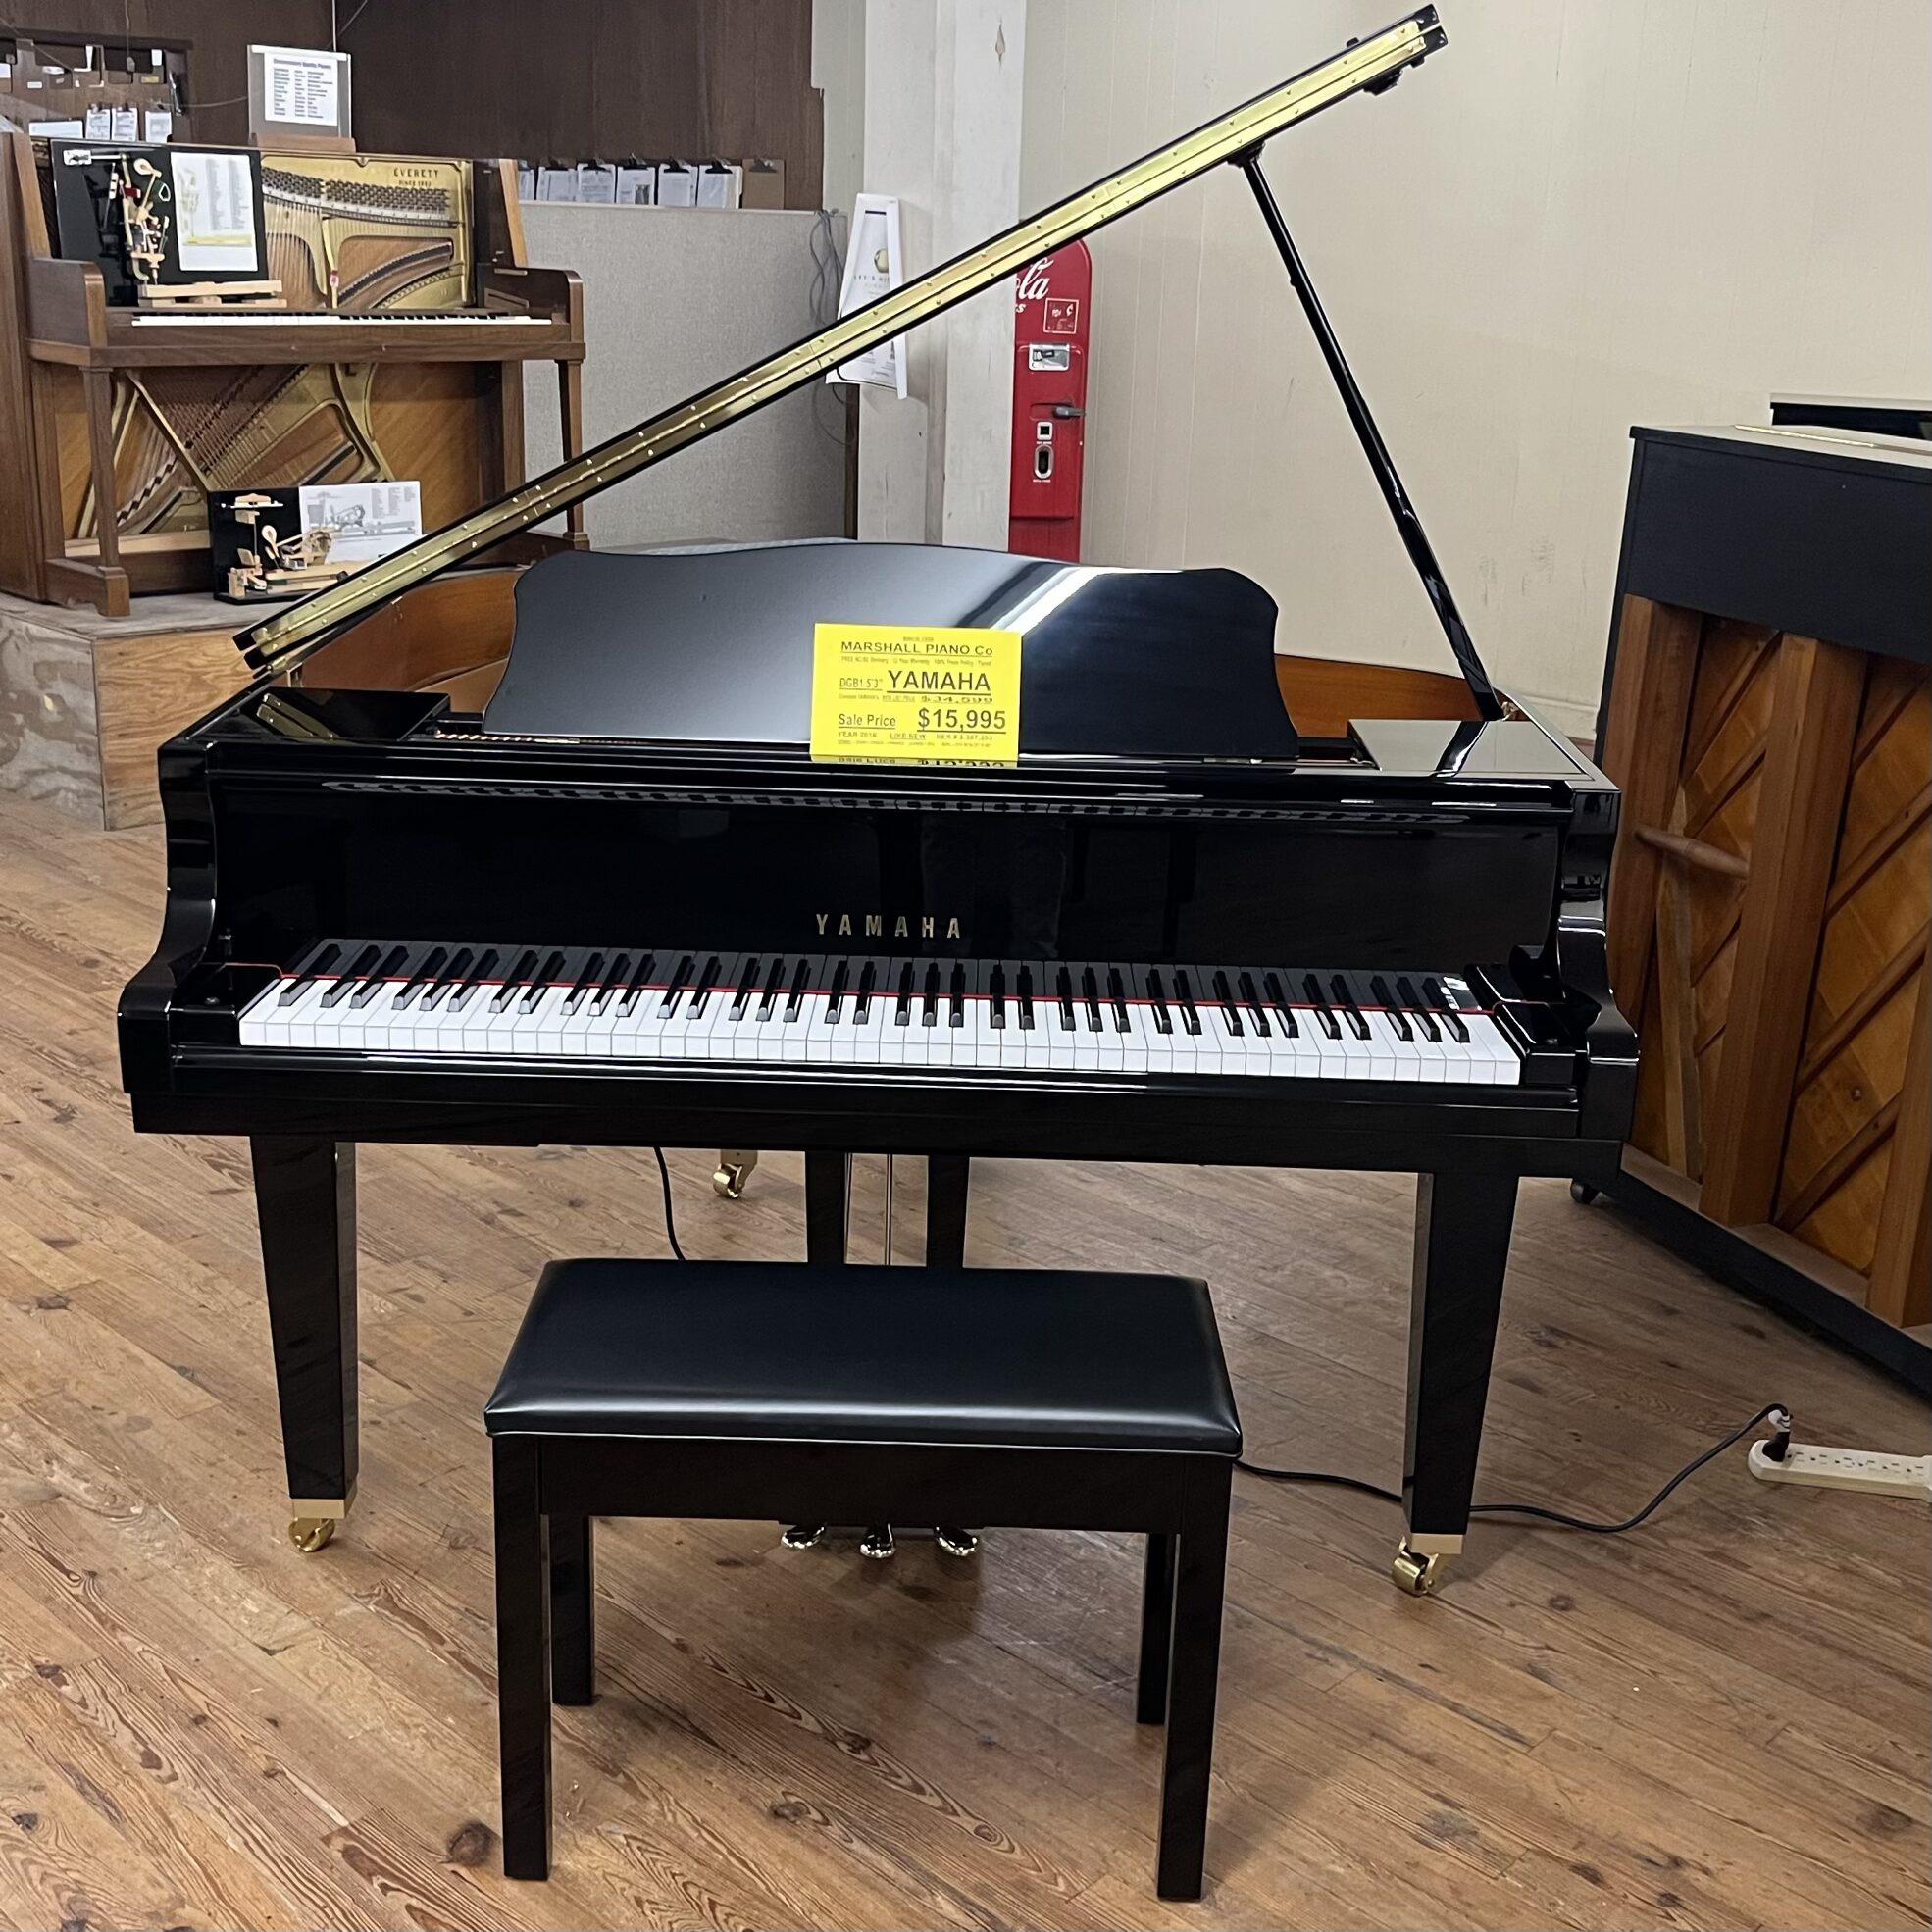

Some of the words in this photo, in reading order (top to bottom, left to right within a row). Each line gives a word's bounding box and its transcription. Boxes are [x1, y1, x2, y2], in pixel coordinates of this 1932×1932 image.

[393, 167, 439, 178] EVERETT
[840, 641, 921, 653] MARSHALL
[925, 643, 971, 655] PIANO
[974, 645, 993, 656] Co
[887, 669, 991, 691] YAMAHA
[839, 713, 863, 726] Sale
[867, 714, 896, 727] Price
[918, 706, 1006, 733] $15,995
[815, 913, 961, 939] YAMAHA
